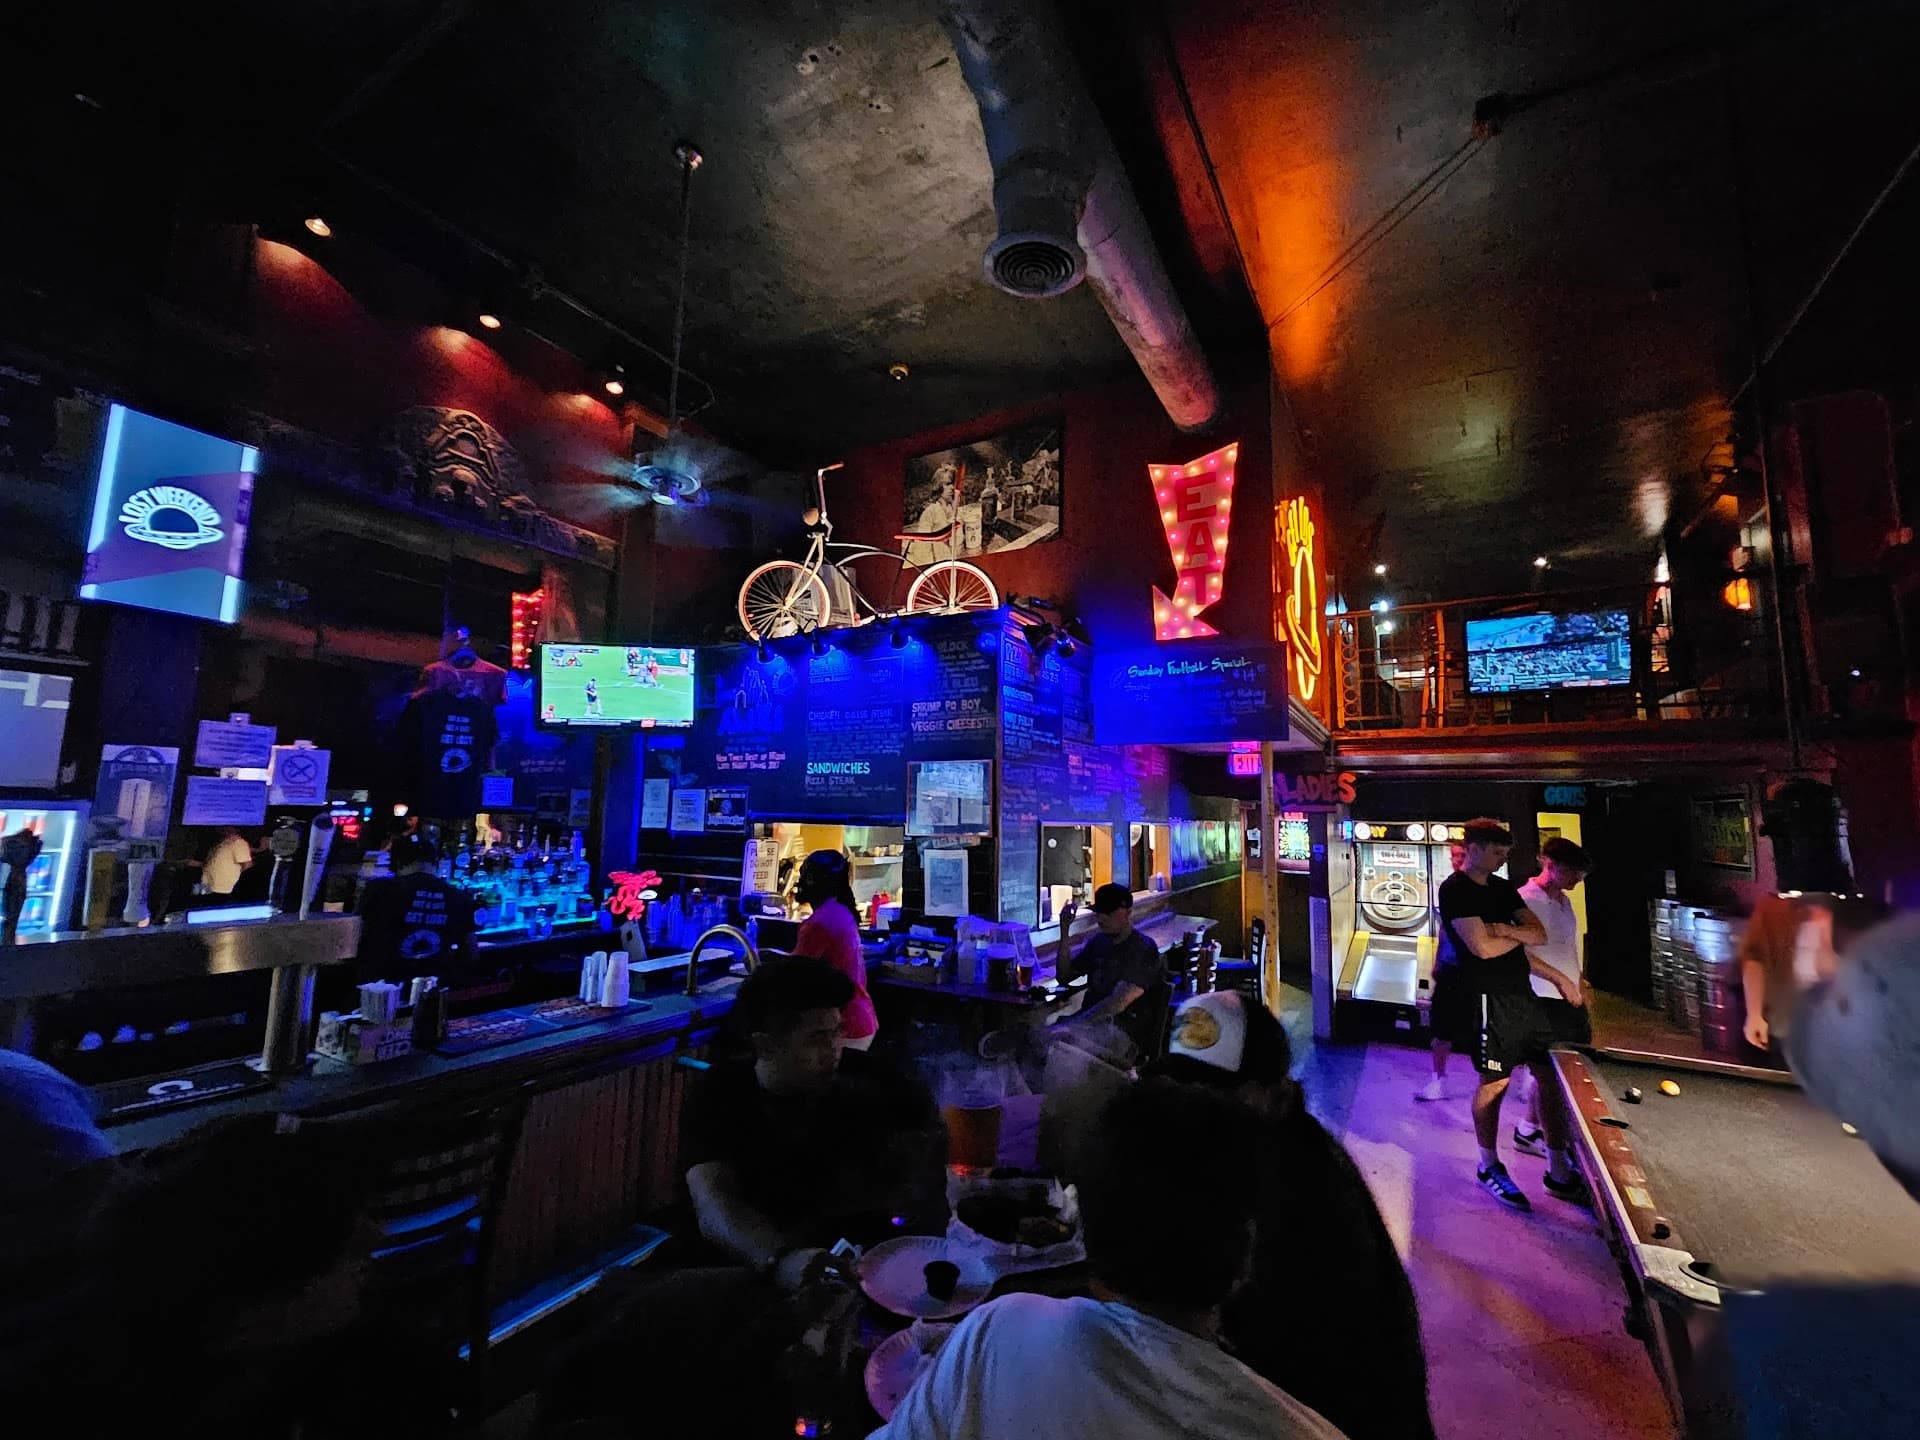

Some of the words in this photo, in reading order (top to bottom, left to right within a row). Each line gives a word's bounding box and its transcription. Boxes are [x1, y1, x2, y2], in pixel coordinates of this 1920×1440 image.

[118, 489, 156, 524] LOST
[149, 486, 222, 526] WEEKEND
[1175, 471, 1220, 606] EAT
[1127, 665, 1164, 678] Sunday
[1167, 660, 1208, 675] Football
[911, 701, 942, 713] SHRIMP
[961, 698, 981, 710] BOY
[911, 720, 945, 732] VEGGIE
[806, 761, 871, 775] SANDWICHES
[1235, 755, 1257, 772] EXIT
[828, 776, 856, 786] STEAK
[1274, 771, 1357, 804] LADIES
